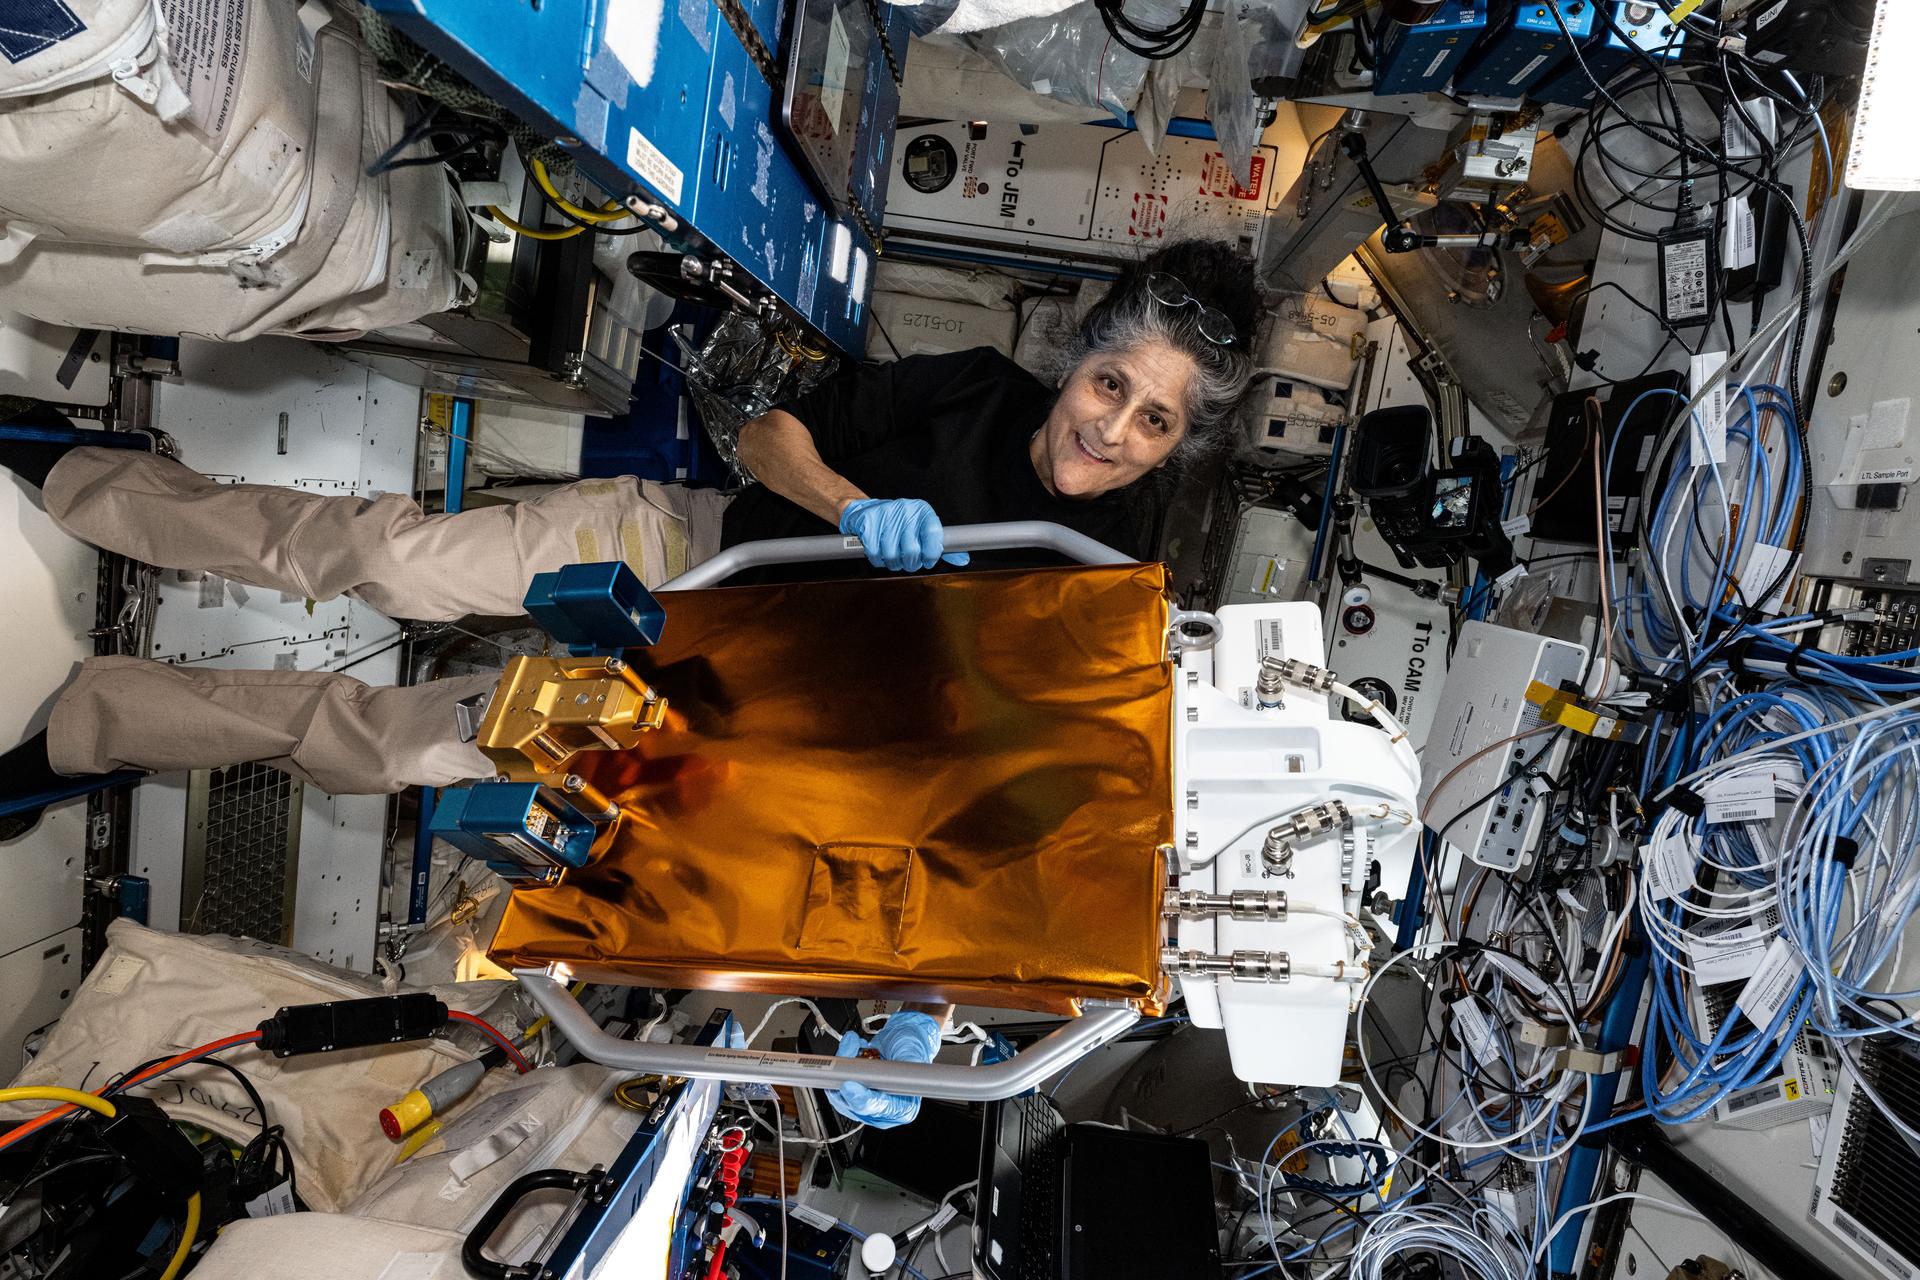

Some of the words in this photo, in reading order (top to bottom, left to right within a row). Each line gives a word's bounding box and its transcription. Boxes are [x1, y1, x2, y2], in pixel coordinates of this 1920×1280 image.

[177, 9, 185, 33] HEPA
[1759, 7, 1778, 25] SUNI
[184, 15, 193, 46] Cleaner
[193, 21, 202, 53] Cleaner
[200, 27, 209, 58] Cleaner
[209, 19, 218, 48] Battery
[174, 34, 182, 56] Filter
[180, 47, 190, 64] Bag
[206, 49, 215, 69] Pack
[228, 42, 241, 86] VACUUM
[216, 86, 232, 132] CLEANER
[1006, 158, 1024, 177] To
[1214, 166, 1223, 185] FIRE
[1248, 163, 1260, 196] WATER
[1000, 182, 1019, 218] JEM
[1144, 201, 1153, 230] BREATHING
[903, 311, 966, 334] 10-5125
[1873, 470, 1896, 480] Sample
[1896, 469, 1909, 478] Port
[1412, 636, 1430, 653] To
[1403, 657, 1426, 692] CAM
[1407, 695, 1415, 712] OVHD
[1404, 712, 1412, 725] FWD
[1797, 1057, 1810, 1096] FORTINET
